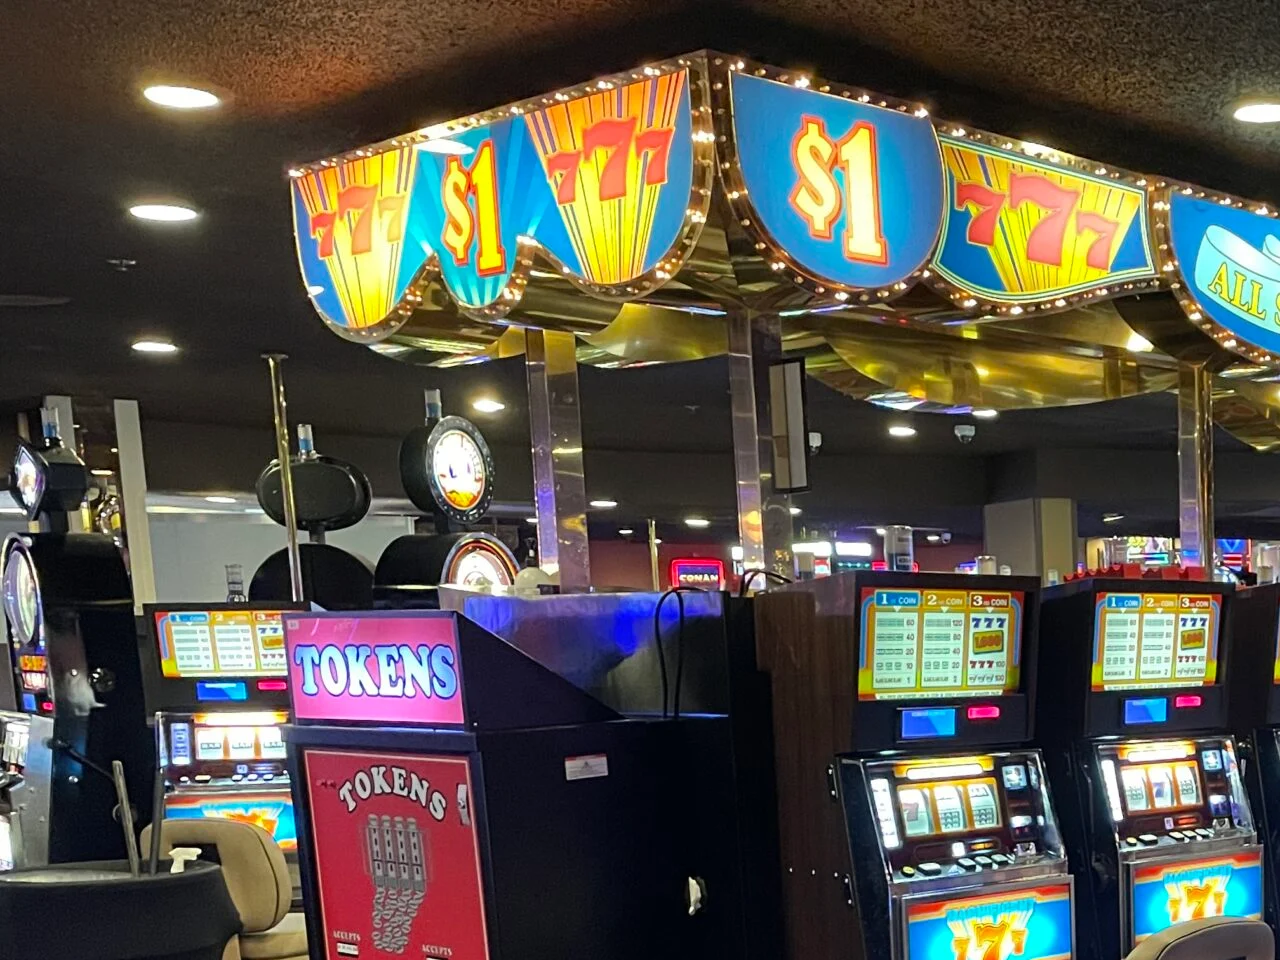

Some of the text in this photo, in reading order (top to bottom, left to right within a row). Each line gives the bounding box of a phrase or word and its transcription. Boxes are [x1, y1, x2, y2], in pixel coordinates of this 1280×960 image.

[547, 115, 676, 206] 777
[441, 138, 506, 277] $1
[788, 113, 889, 267] $1
[310, 183, 407, 260] 777
[955, 173, 1120, 273] 777
[1208, 262, 1267, 320] ALL
[679, 573, 719, 583] CONAN
[927, 595, 937, 606] 2
[973, 595, 983, 606] 3
[294, 643, 458, 700] TOKENS
[338, 764, 448, 821] TOKENS
